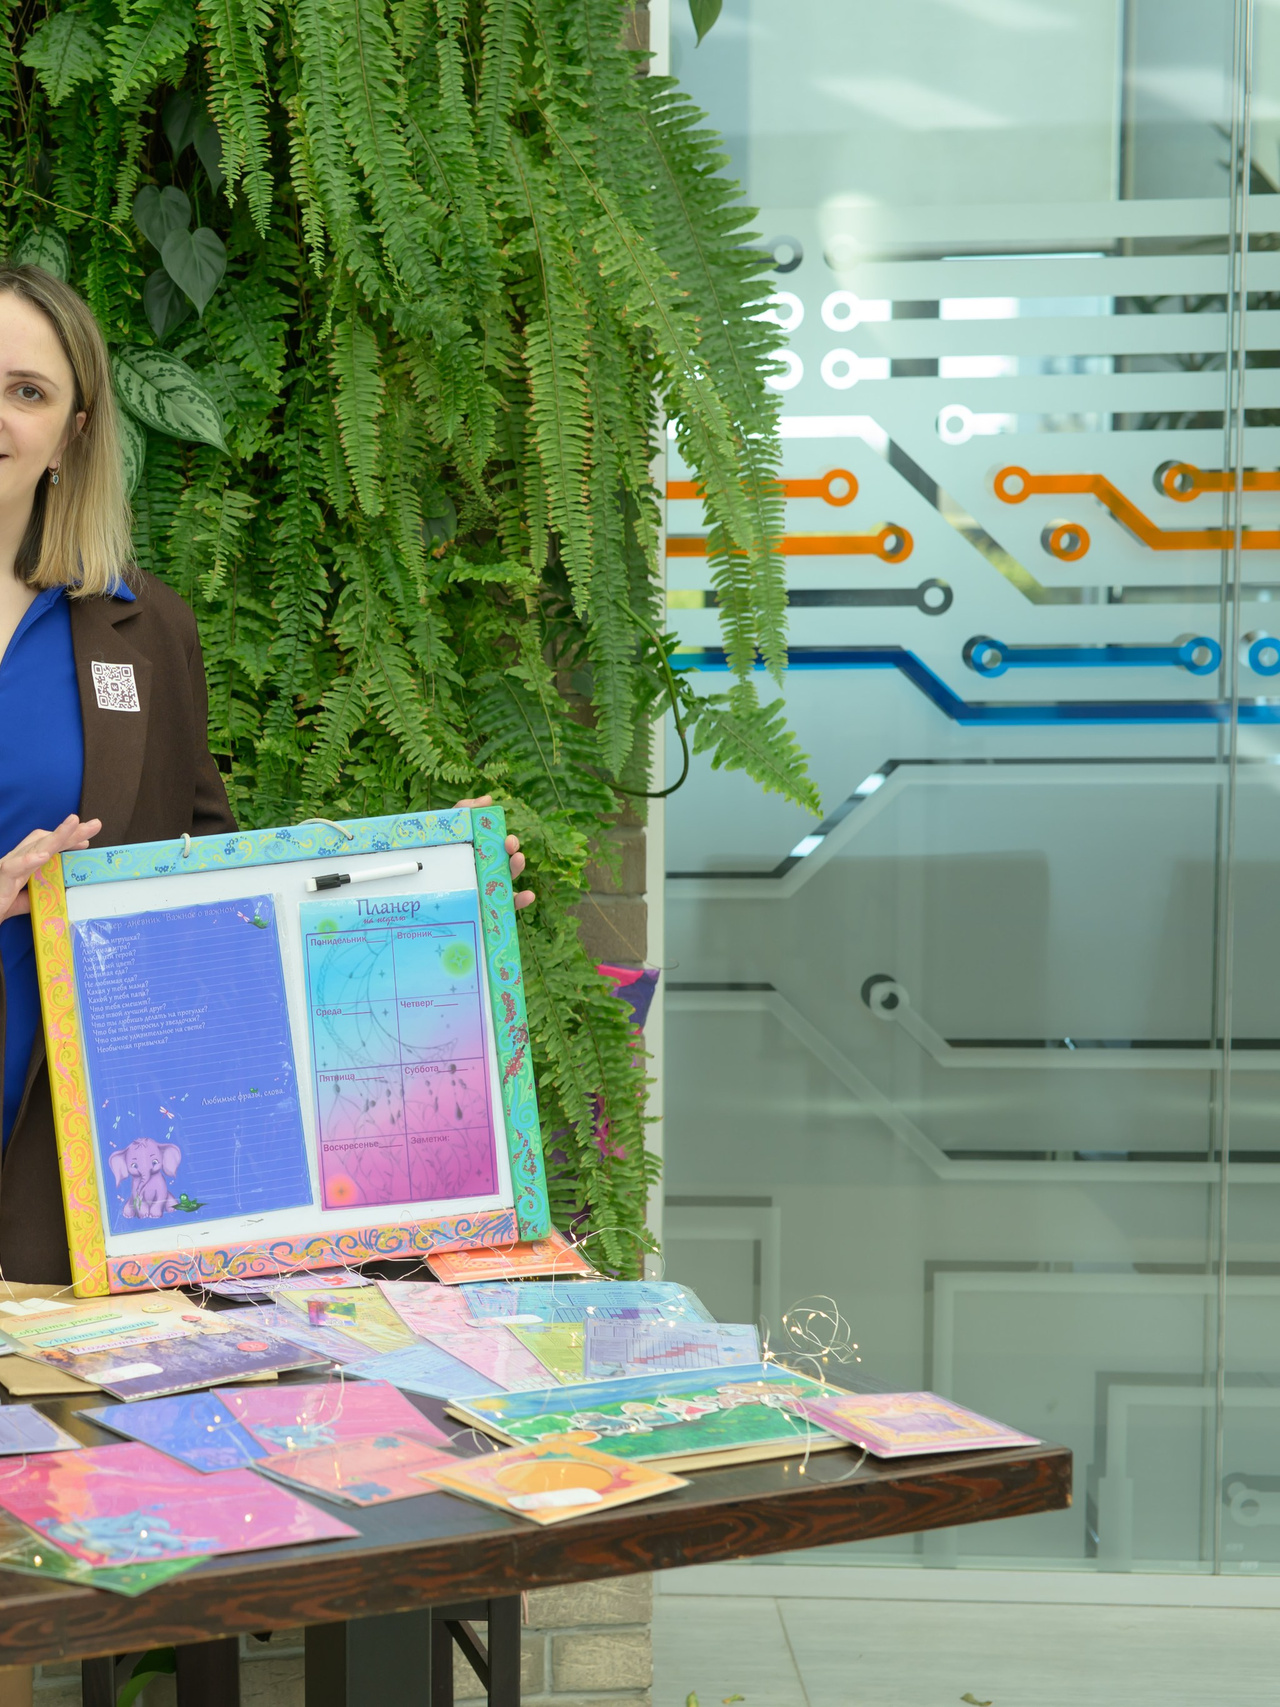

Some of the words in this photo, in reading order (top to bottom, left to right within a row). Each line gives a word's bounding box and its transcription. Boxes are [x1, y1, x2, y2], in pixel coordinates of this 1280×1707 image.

[356, 899, 421, 919] Планер
[96, 920, 122, 933] Трер
[397, 930, 433, 940] Вторник
[82, 953, 114, 963] Любый
[400, 999, 434, 1009] Четверг
[315, 1008, 342, 1018] Среда
[404, 1064, 439, 1076] Суббота
[319, 1072, 356, 1083] Пятница
[201, 1095, 237, 1106] Любимые
[410, 1134, 450, 1145] Заметки:
[323, 1140, 379, 1152] Воскресенье
